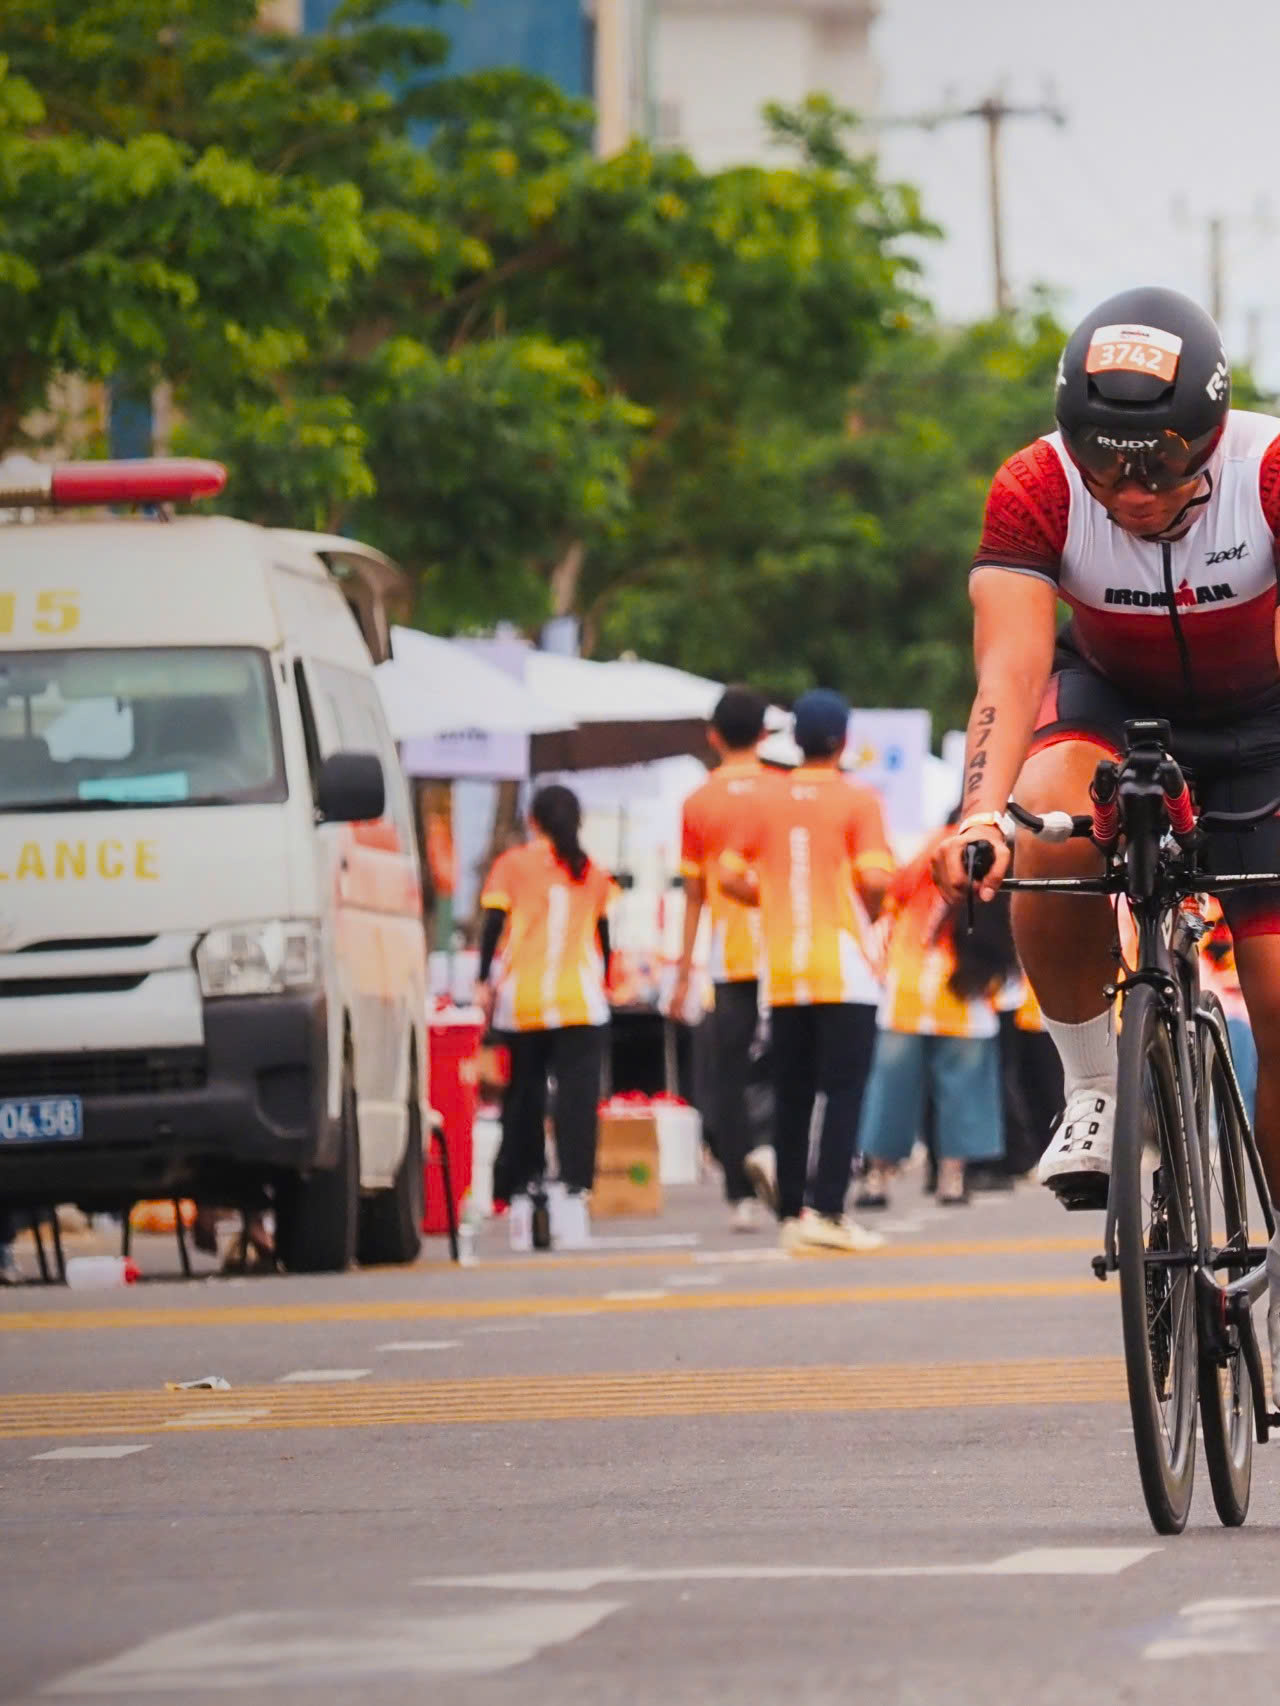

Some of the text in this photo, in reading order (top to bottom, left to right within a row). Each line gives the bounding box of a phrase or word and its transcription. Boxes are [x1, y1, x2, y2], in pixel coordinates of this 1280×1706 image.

[1099, 342, 1163, 372] 3742
[1097, 435, 1159, 449] RUDY
[1104, 578, 1237, 608] IRONMAN
[967, 706, 996, 793] 3742
[0, 839, 162, 882] ANCE
